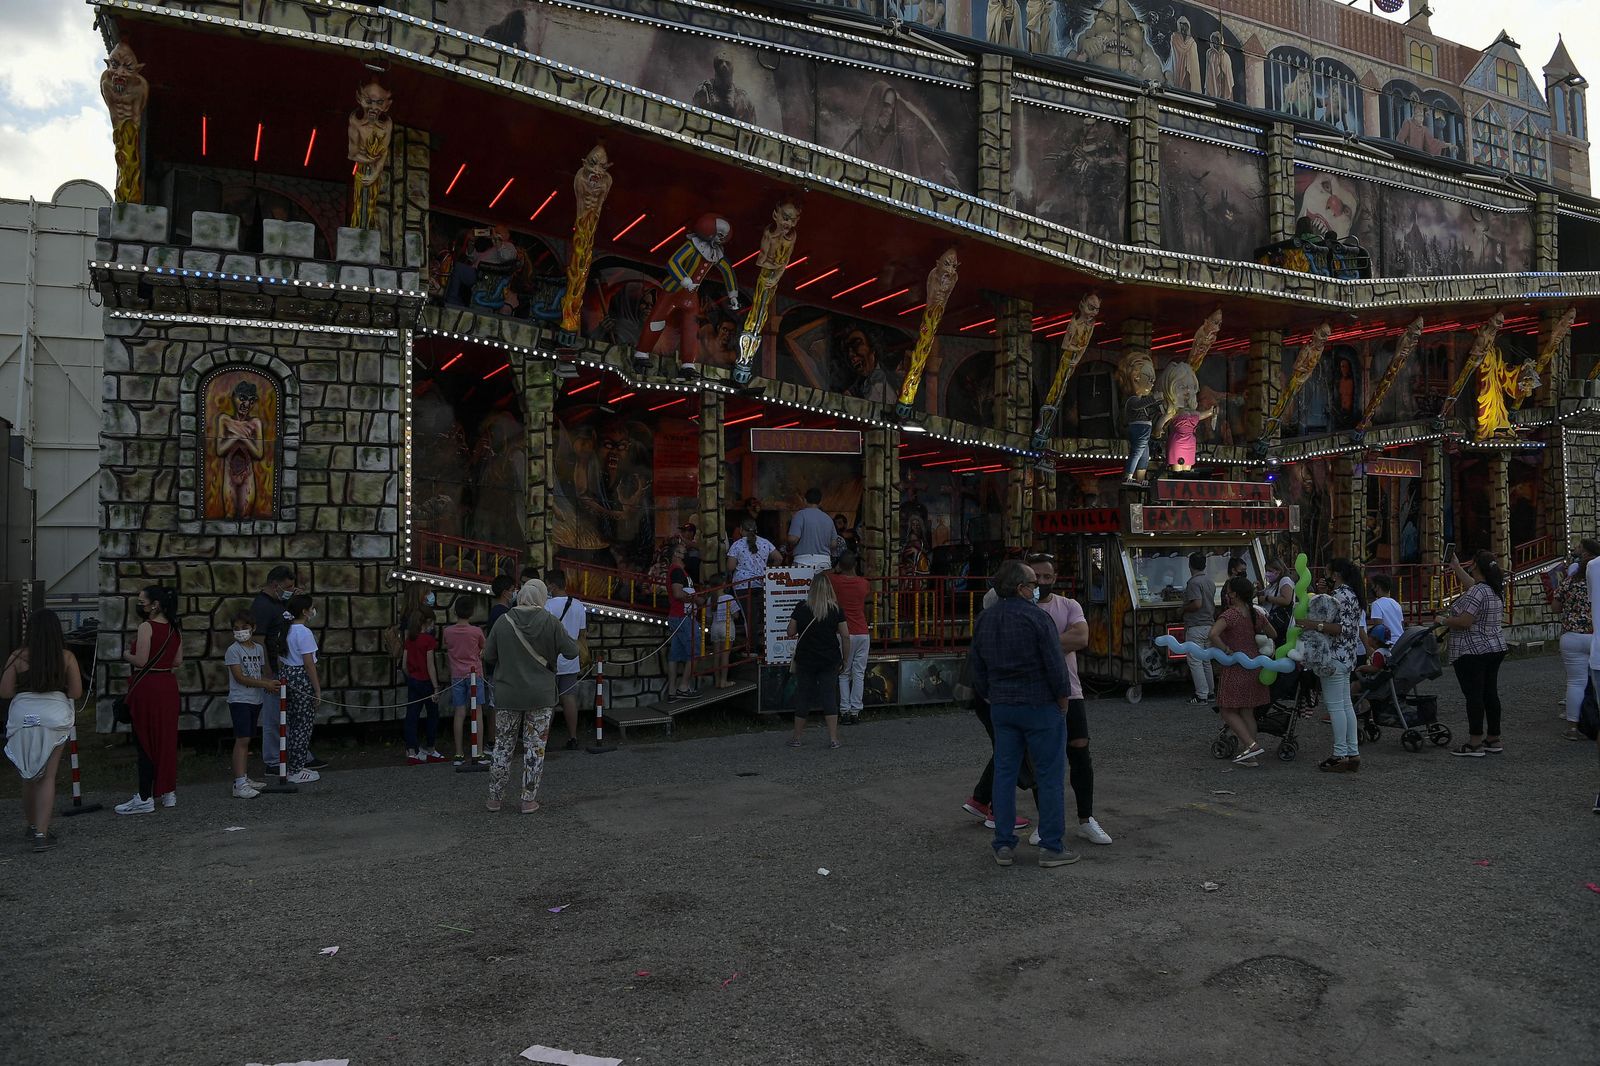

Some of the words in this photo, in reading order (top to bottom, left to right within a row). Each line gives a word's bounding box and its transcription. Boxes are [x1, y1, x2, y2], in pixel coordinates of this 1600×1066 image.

[1374, 462, 1413, 475] SALIDA
[1166, 482, 1263, 499] TAQUILLA
[1037, 511, 1121, 530] TAQUILLA
[1203, 508, 1231, 527] DEL
[1241, 508, 1286, 527] MIEDO
